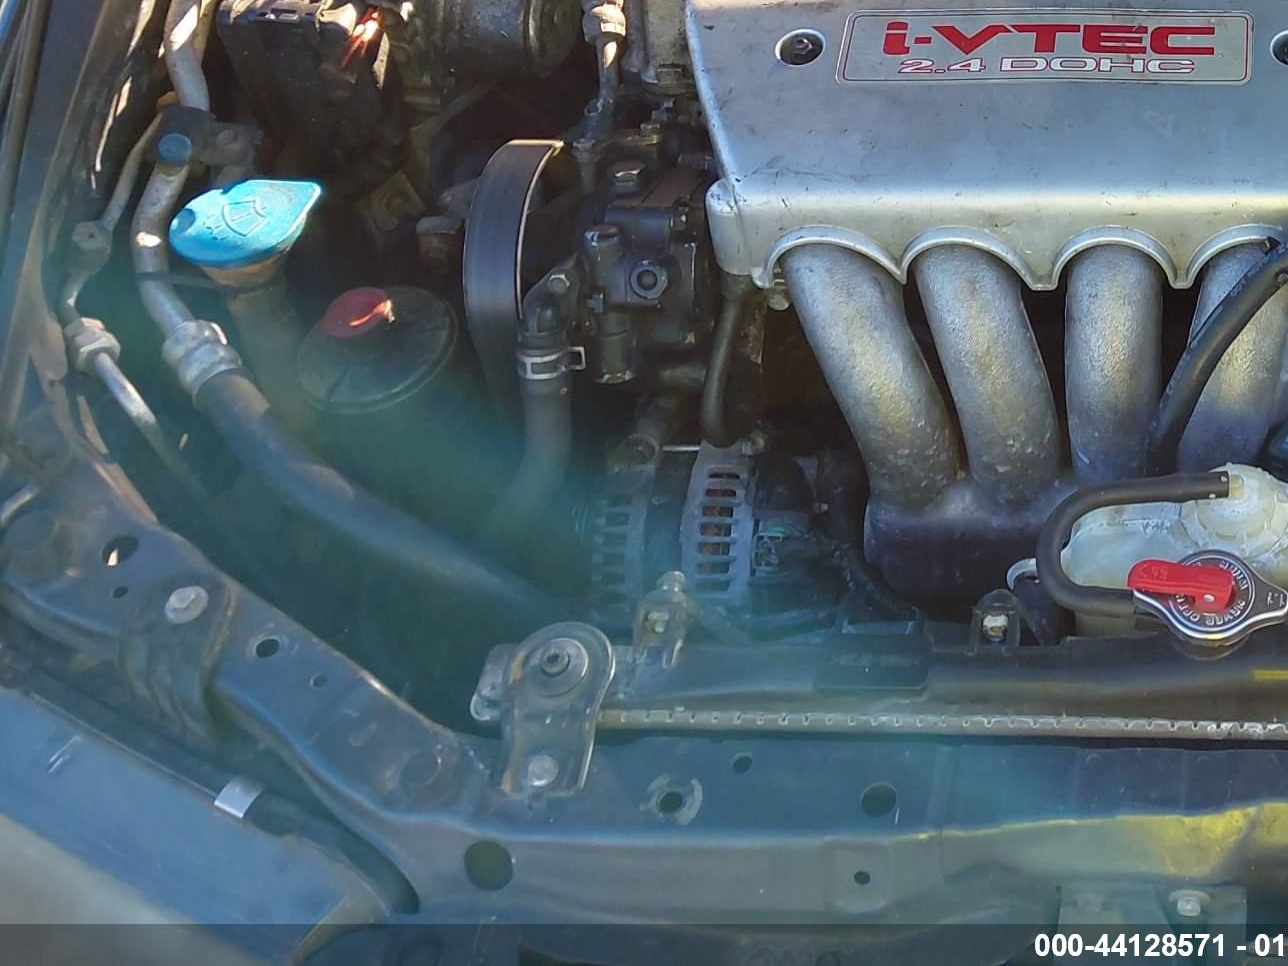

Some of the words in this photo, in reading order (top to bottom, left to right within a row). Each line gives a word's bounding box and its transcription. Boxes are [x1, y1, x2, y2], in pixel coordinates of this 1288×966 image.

[882, 21, 1216, 56] i-VTEC
[897, 57, 986, 74] 2.4
[1000, 57, 1195, 74] DOHC
